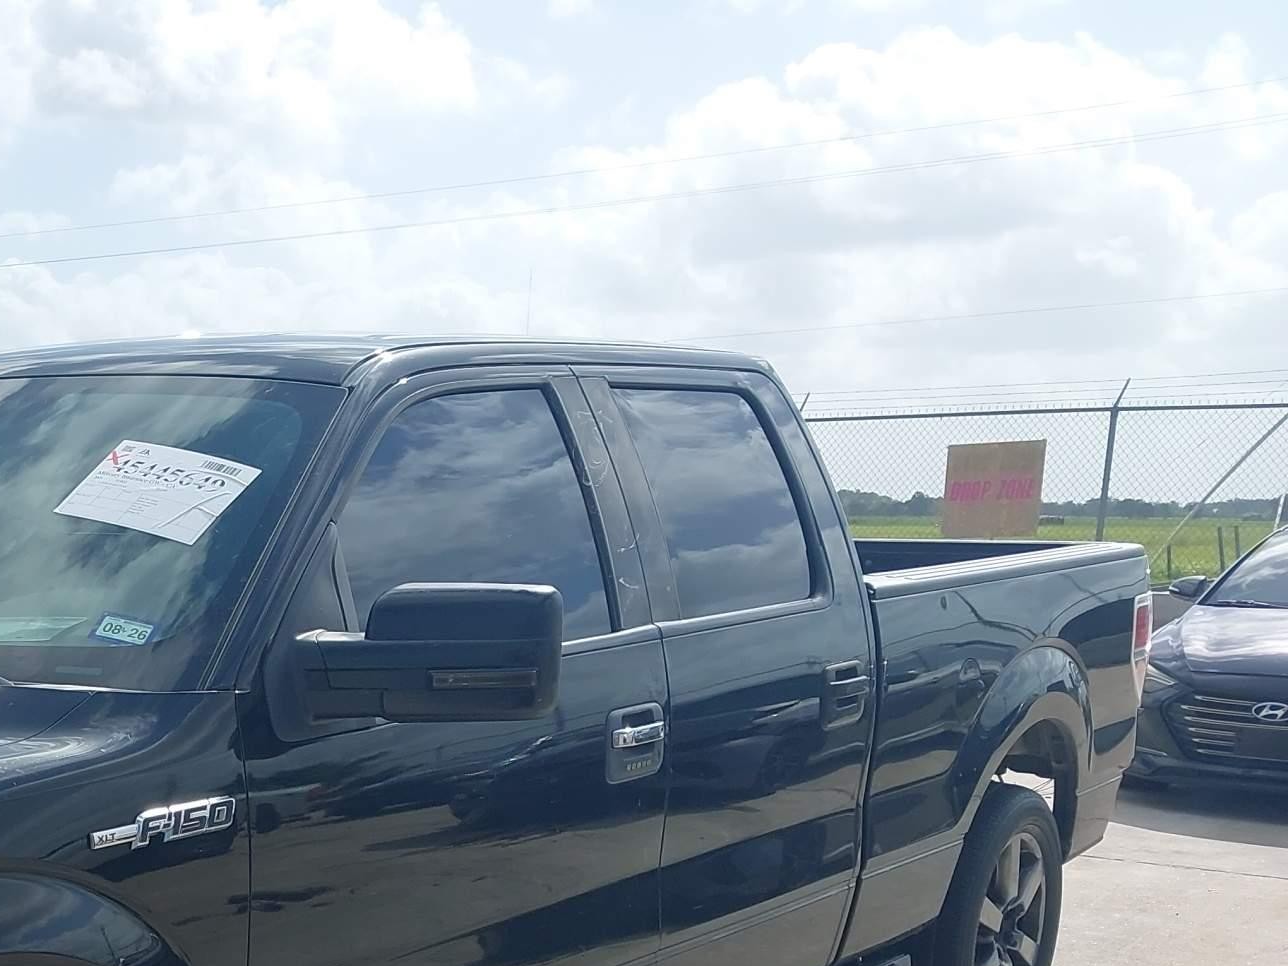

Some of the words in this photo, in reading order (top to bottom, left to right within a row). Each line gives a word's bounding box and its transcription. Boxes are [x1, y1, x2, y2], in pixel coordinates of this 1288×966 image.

[112, 459, 226, 493] 45445649
[950, 480, 992, 502] DROP
[997, 478, 1033, 500] ZONE
[102, 622, 123, 635] 08
[127, 627, 149, 641] 26
[96, 833, 117, 845] XLT
